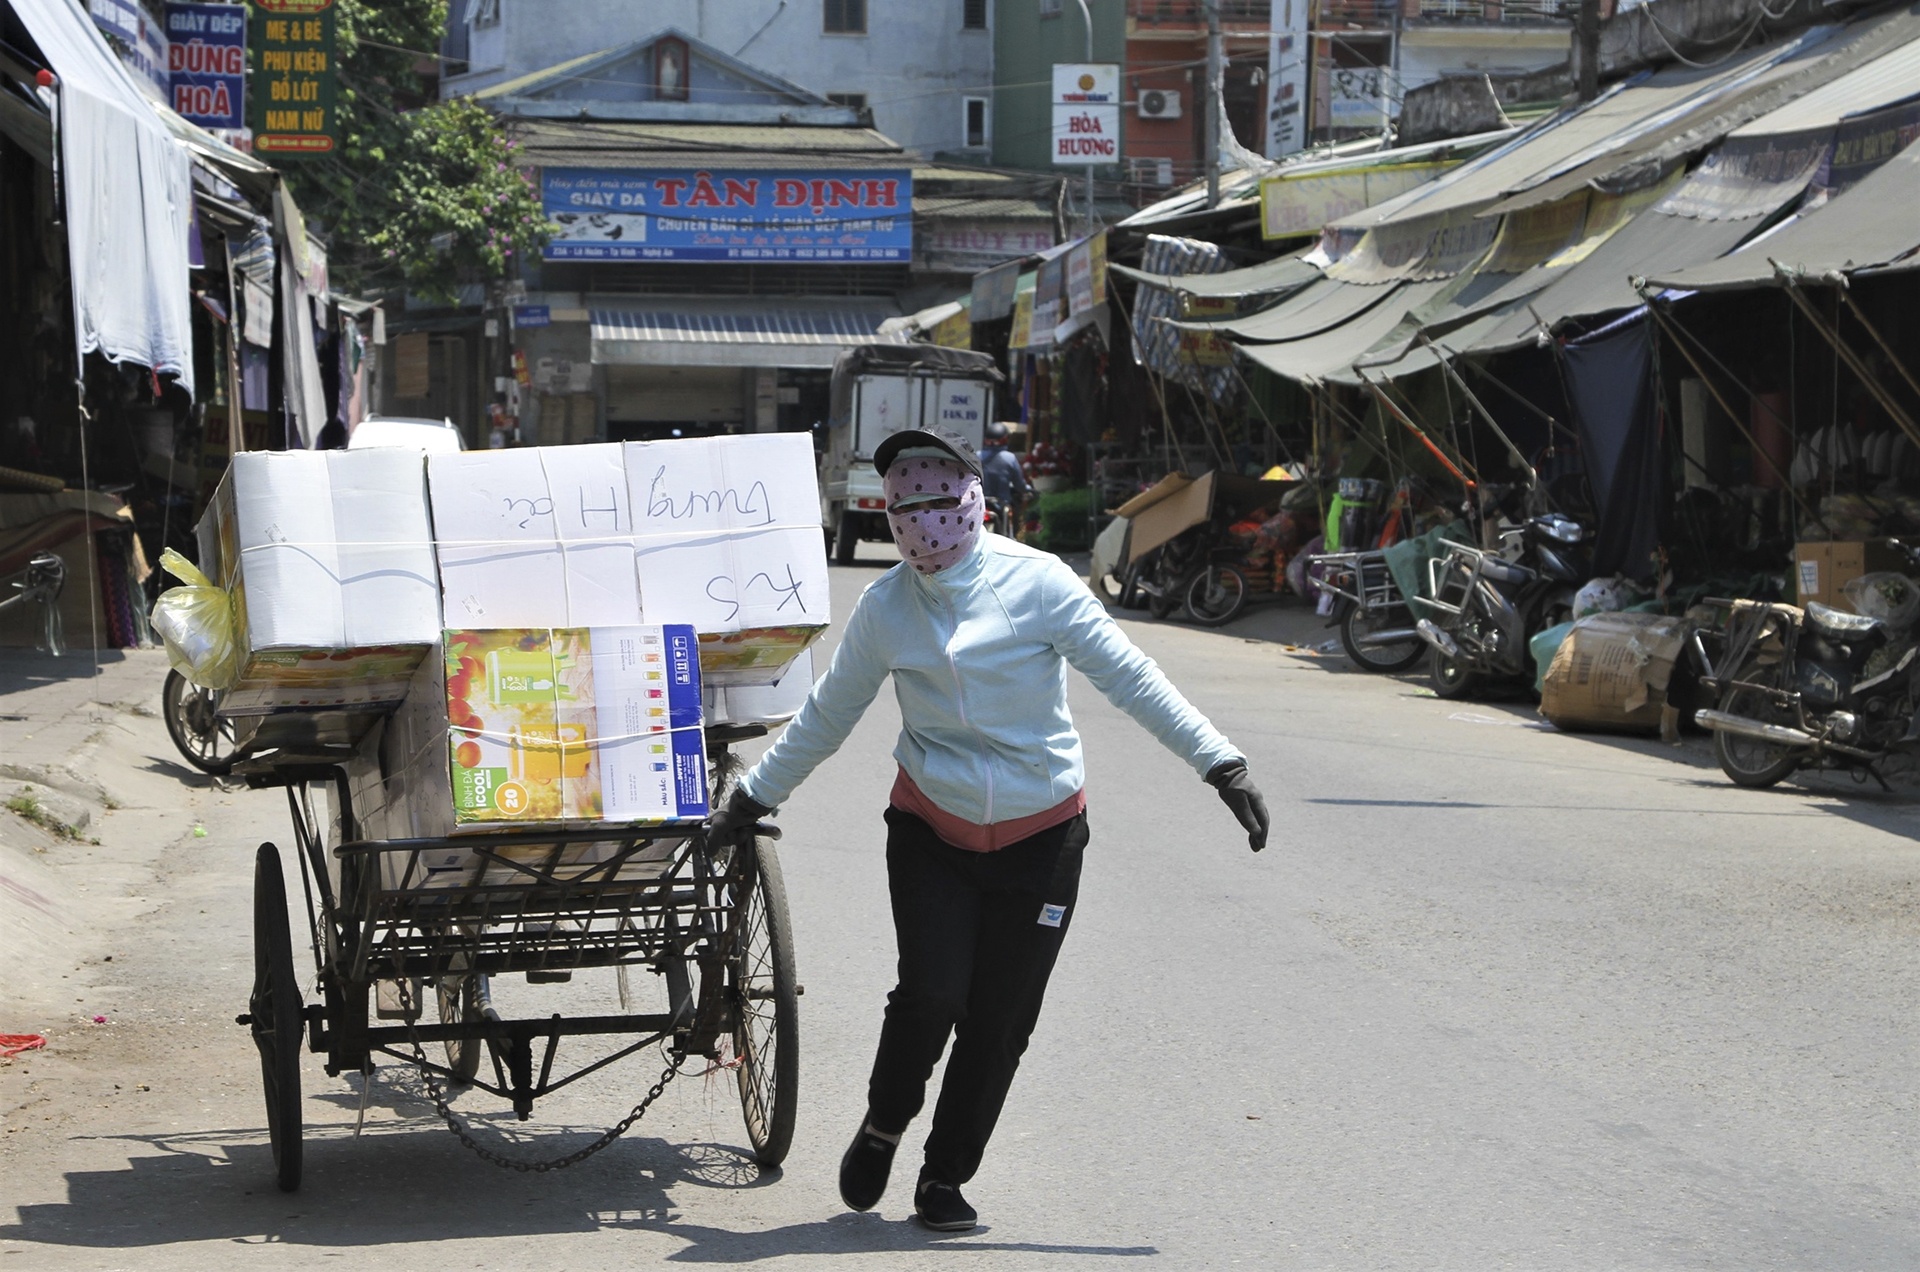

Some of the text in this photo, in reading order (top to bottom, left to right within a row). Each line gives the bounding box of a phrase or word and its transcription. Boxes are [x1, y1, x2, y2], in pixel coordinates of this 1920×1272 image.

[170, 11, 242, 34] GIÀY DÉP
[266, 17, 322, 44] MẸ & BÉ
[263, 48, 327, 75] PHỤ KIỆN
[175, 80, 232, 117] HOÀ
[266, 110, 299, 130] NAM
[1069, 111, 1102, 133] HÒA
[622, 181, 647, 189] xem
[654, 170, 899, 215] TÂN ĐỊNH
[620, 192, 646, 206] DA
[647, 465, 776, 528] Trung
[461, 769, 474, 808] BÌNH ĐÁ
[474, 769, 487, 807] ICOOL
[504, 789, 519, 808] 20
